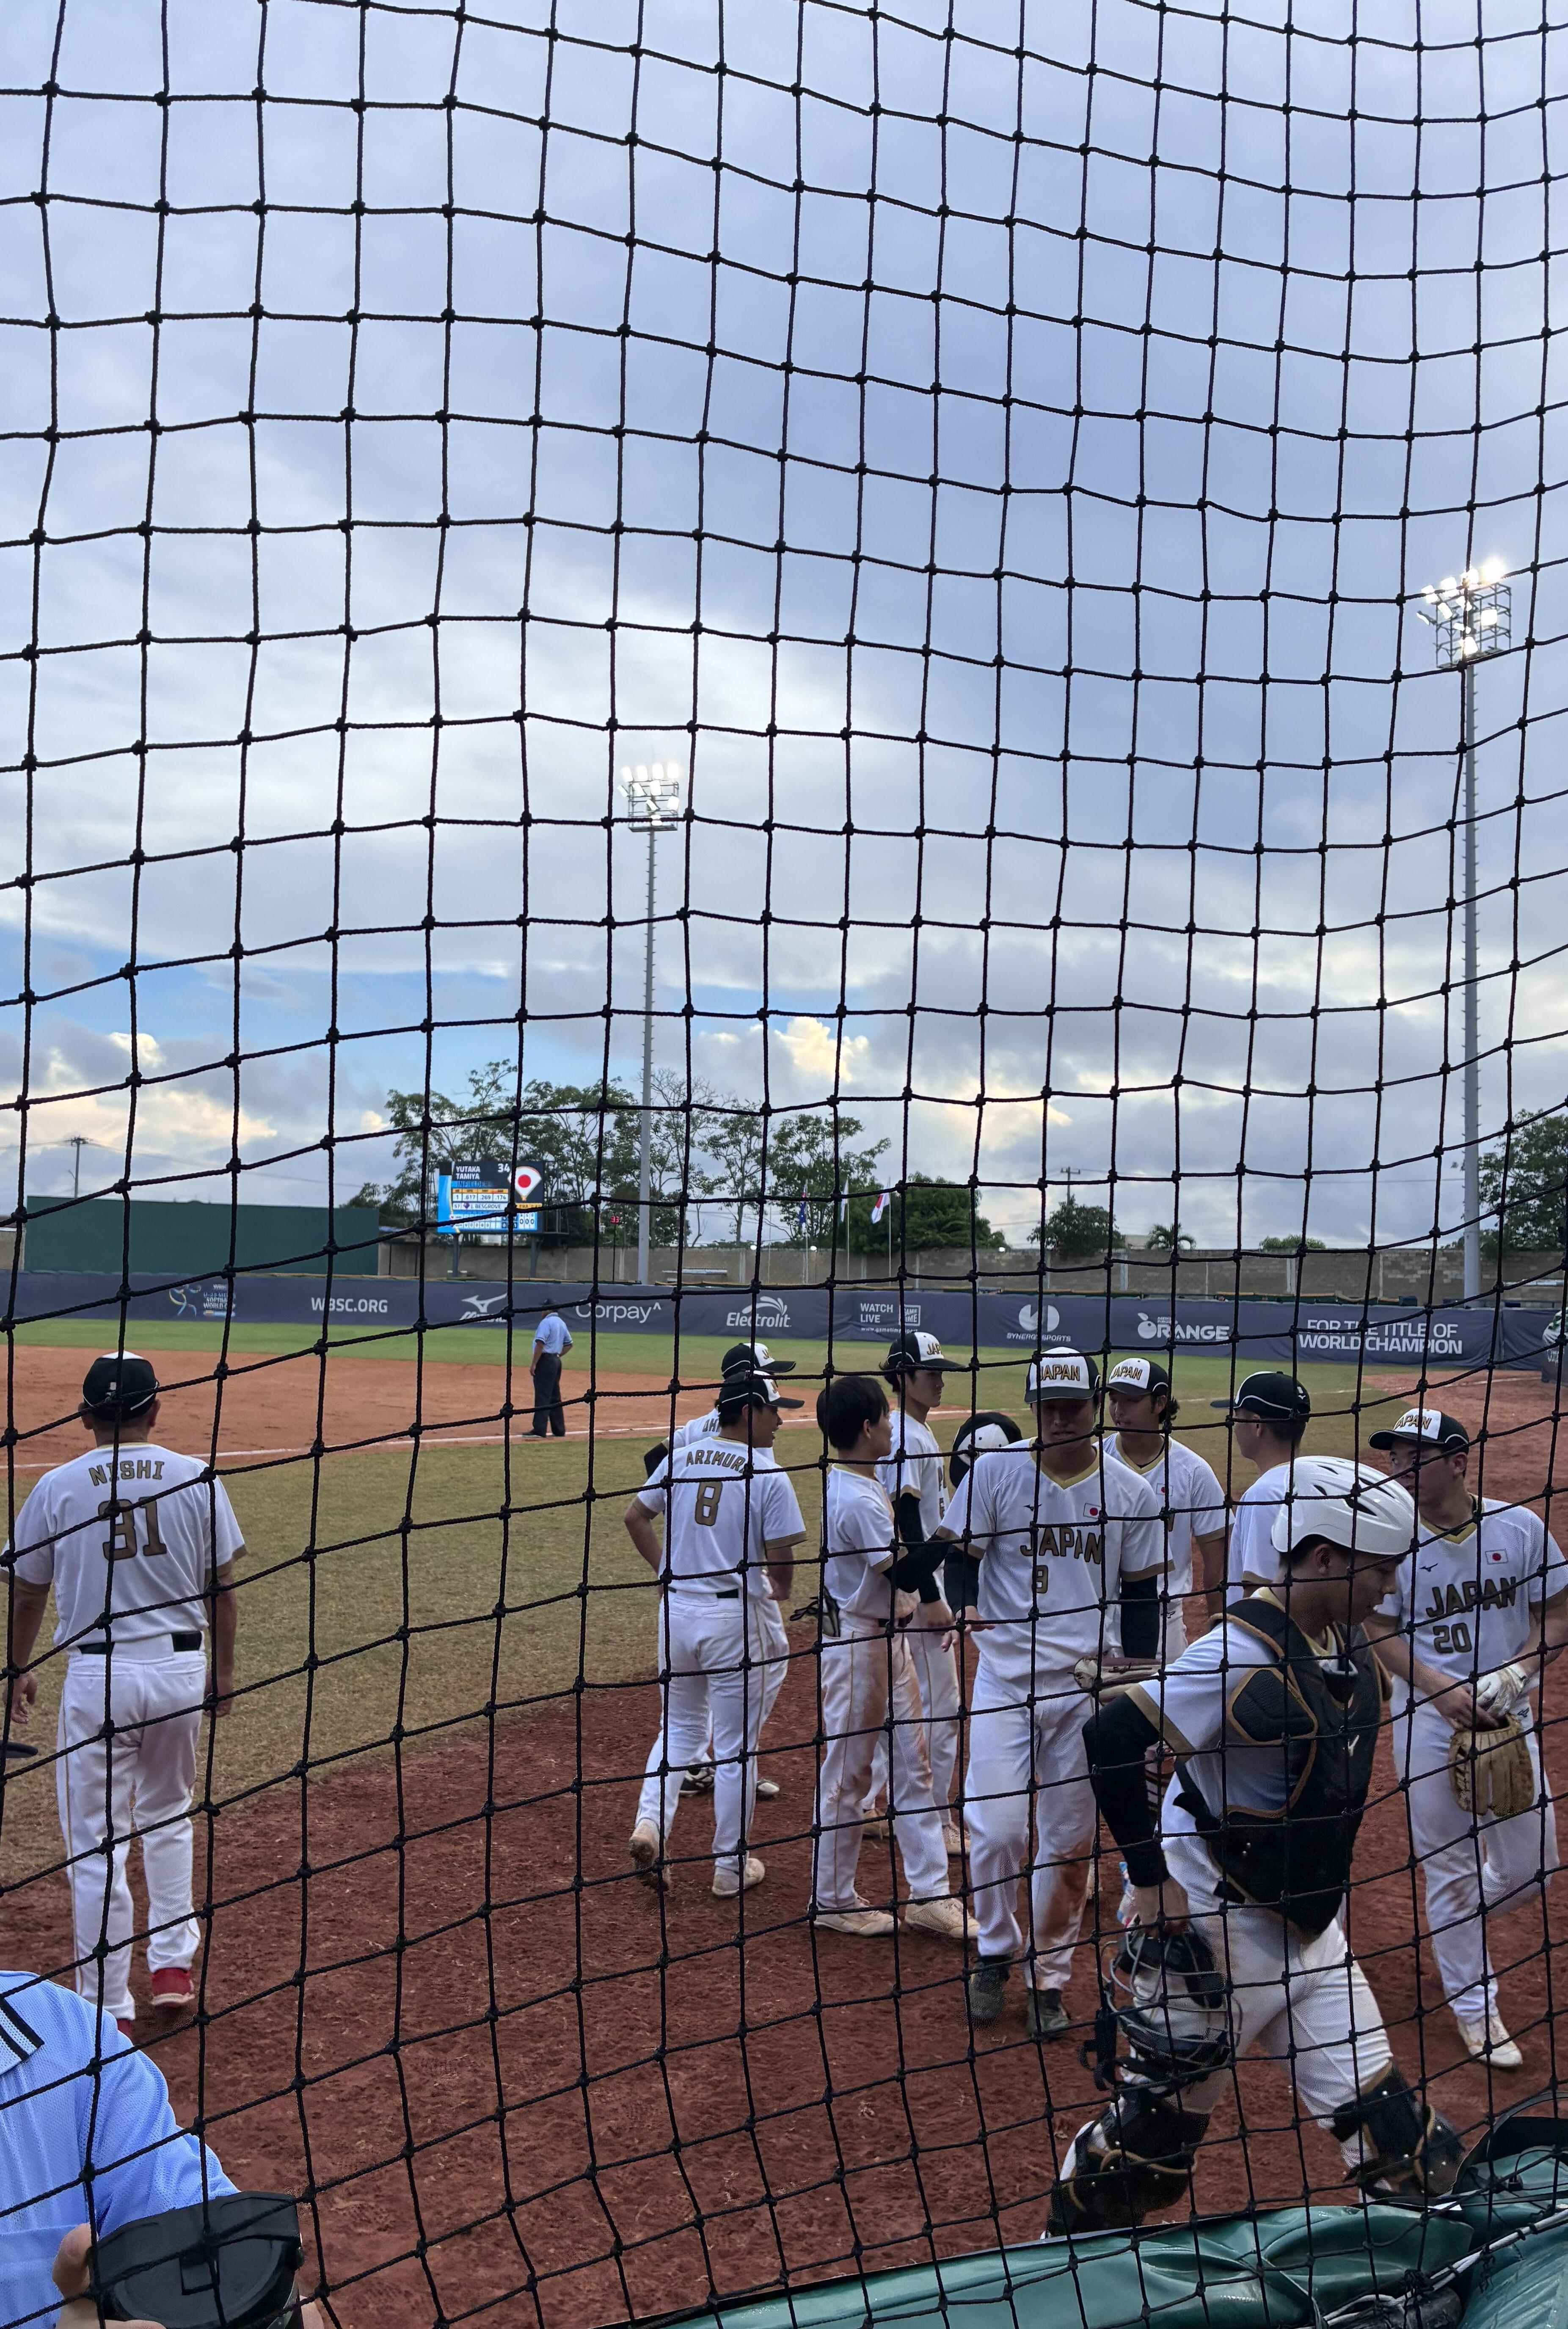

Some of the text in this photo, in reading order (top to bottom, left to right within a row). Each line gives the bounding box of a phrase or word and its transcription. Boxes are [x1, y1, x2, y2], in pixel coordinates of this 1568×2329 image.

[498, 1163, 510, 1172] 34
[311, 1297, 388, 1313] WBSC.ORG
[860, 1303, 893, 1313] WATCH
[860, 1314, 881, 1323] LIVE
[1007, 1332, 1040, 1341] SYNERG
[1307, 1319, 1341, 1334] FOR
[1383, 1322, 1427, 1337] TITLE
[1433, 1323, 1458, 1338] OF
[1299, 1334, 1462, 1354] WORLD CHAMPION
[1393, 1415, 1432, 1430] APAN
[88, 1460, 165, 1486] NISHI
[694, 1479, 723, 1527] 8
[98, 1496, 167, 1561] 31
[1020, 1526, 1106, 1565] JAPAN
[1426, 1576, 1516, 1618] JAPAN
[1433, 1622, 1472, 1654] 20
